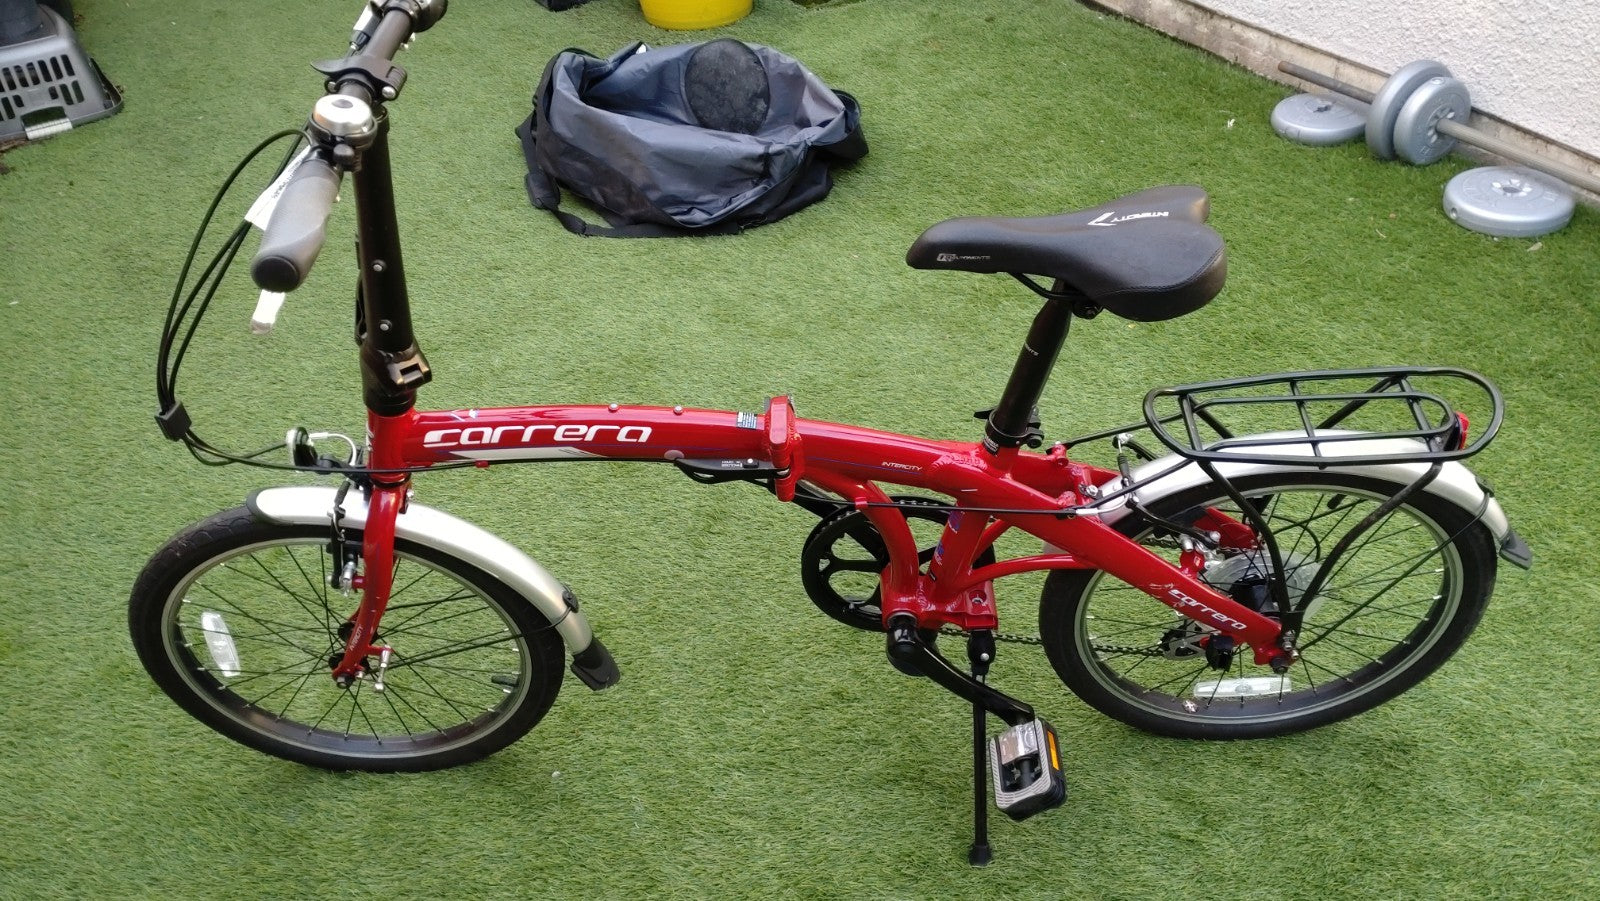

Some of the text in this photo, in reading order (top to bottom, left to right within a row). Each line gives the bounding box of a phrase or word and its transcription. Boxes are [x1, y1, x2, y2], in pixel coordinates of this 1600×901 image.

[423, 424, 653, 448] carrera
[881, 461, 924, 471] INTERCITY
[1168, 589, 1248, 630] carrera
